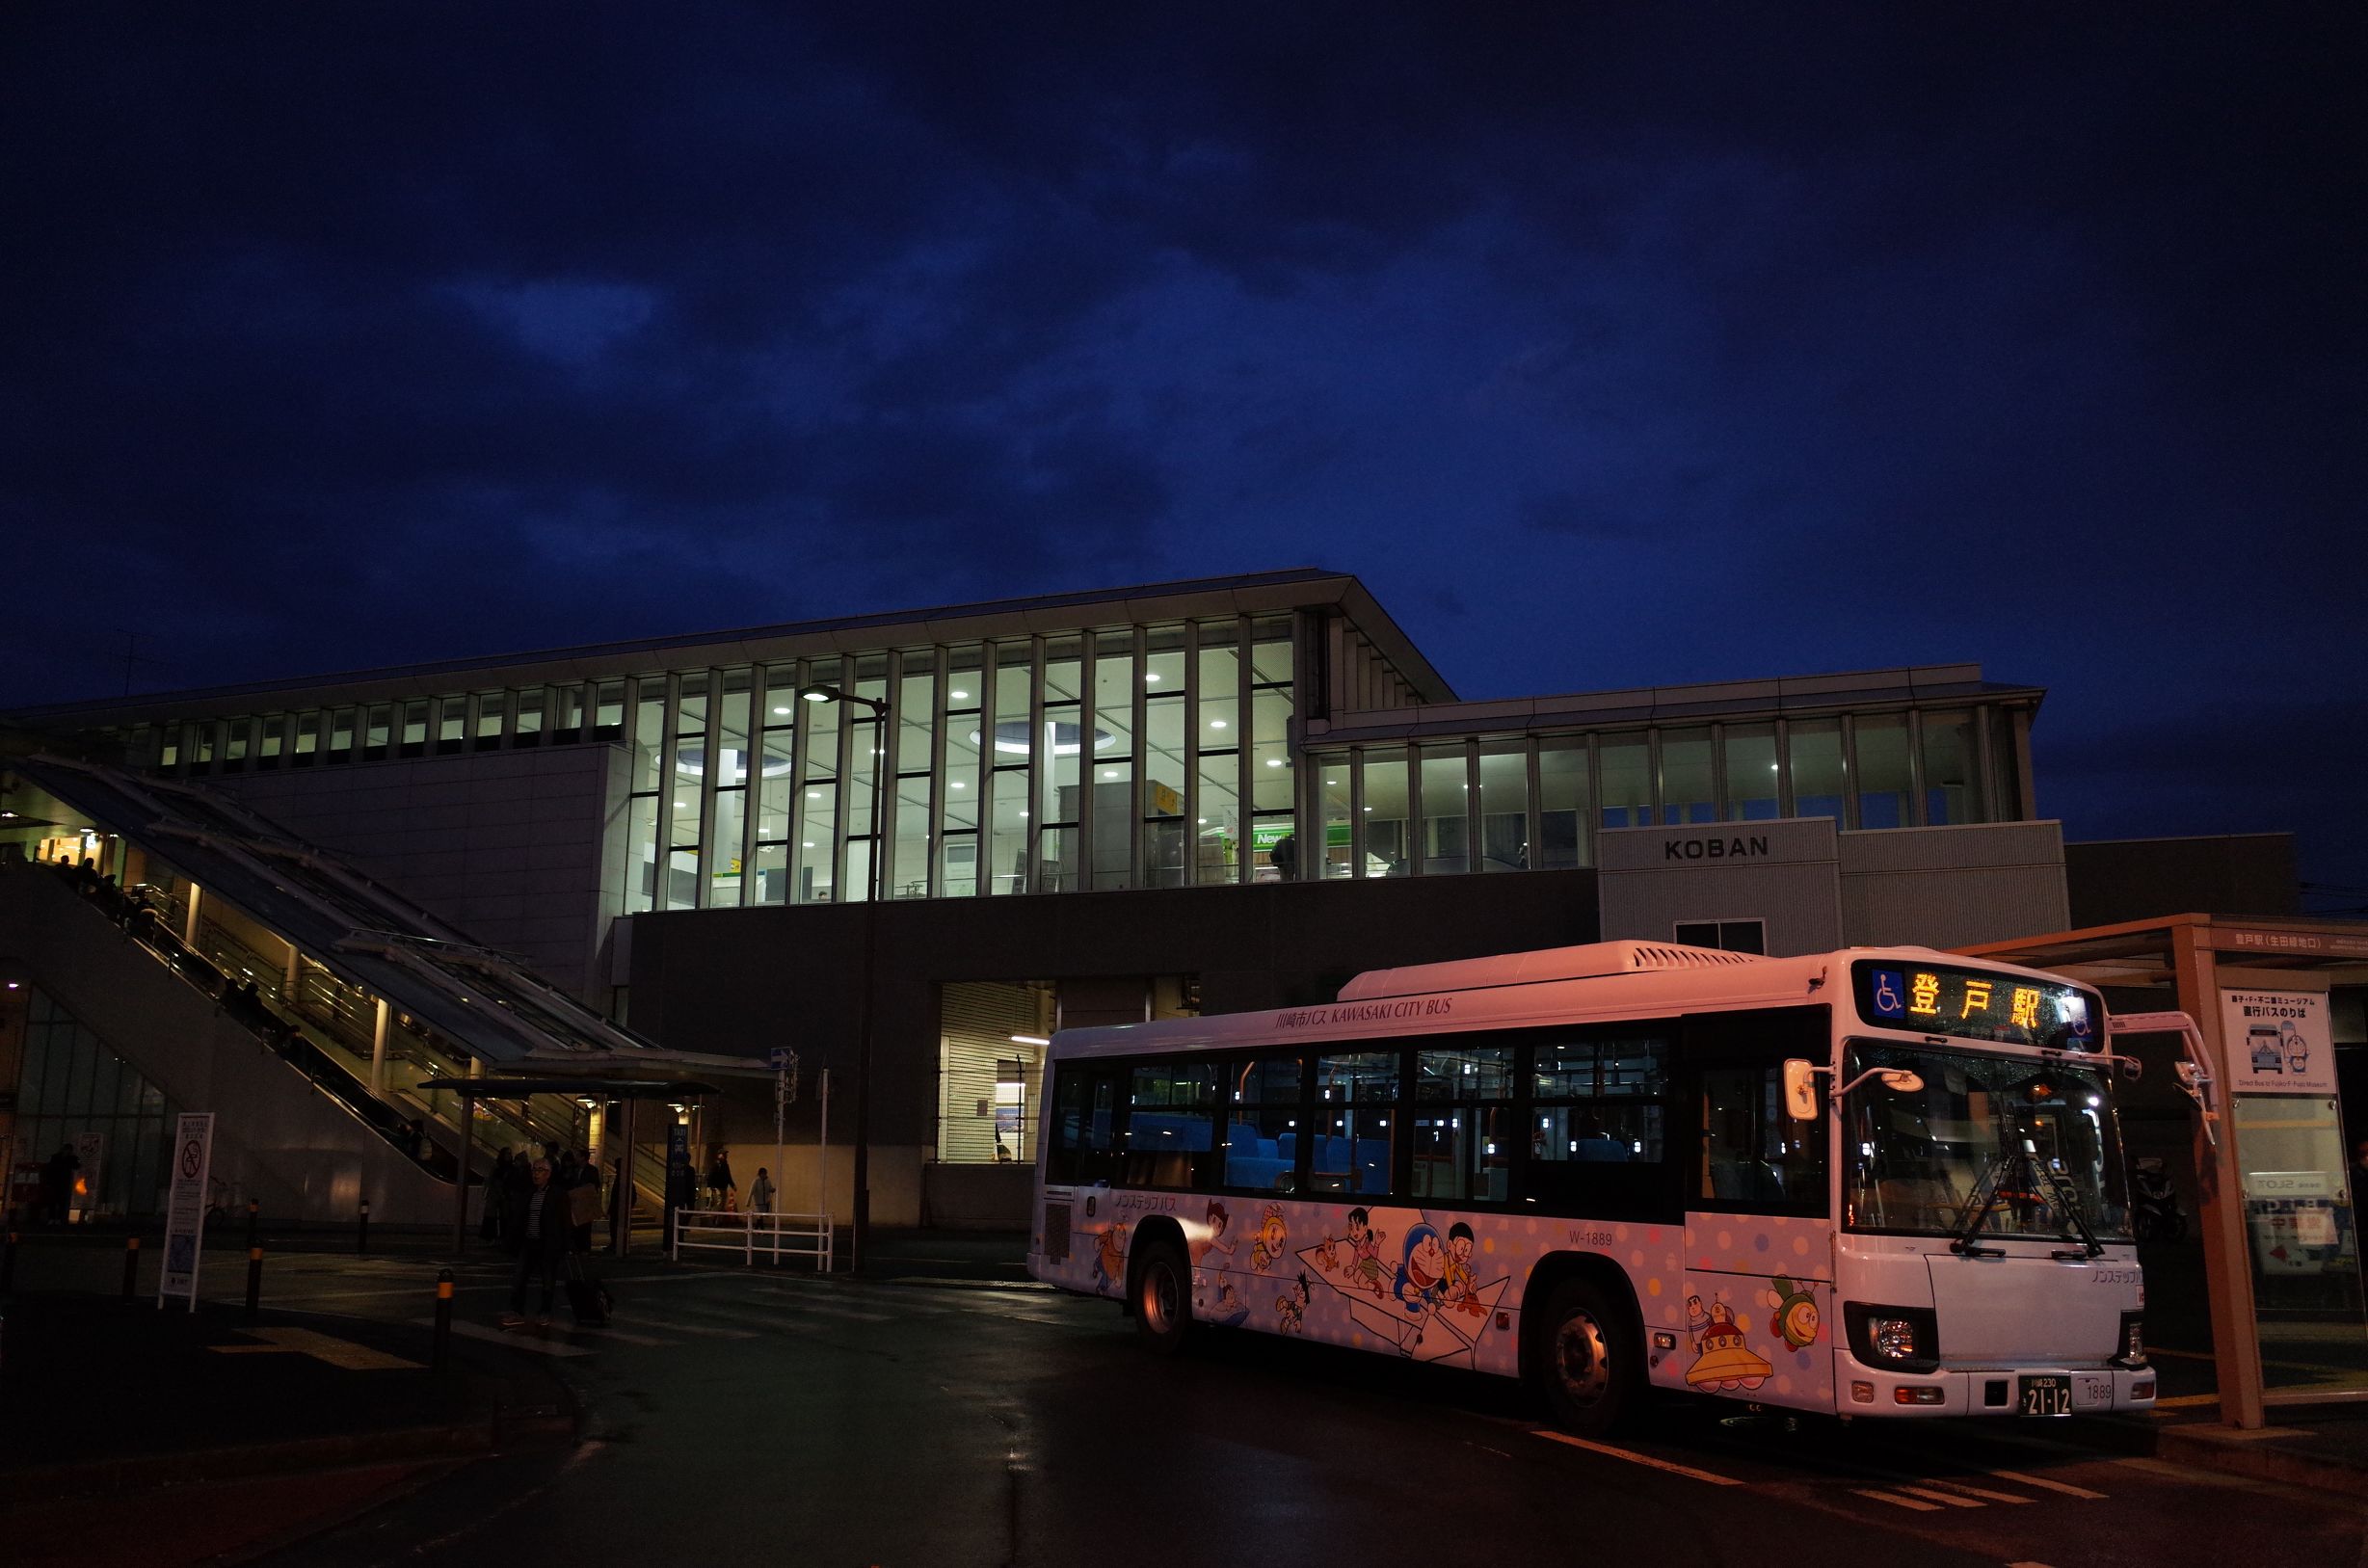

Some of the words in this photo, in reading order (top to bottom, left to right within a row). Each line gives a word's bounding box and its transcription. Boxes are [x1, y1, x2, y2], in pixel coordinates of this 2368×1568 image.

[1664, 836, 1769, 860] KOBAN
[1909, 971, 2041, 1028] 登戸駅
[1275, 1009, 1326, 1029] 川崎市バス
[1331, 1003, 1393, 1023] KAWASAKI
[1394, 1000, 1423, 1018] CITY
[1425, 997, 1452, 1015] BUS
[2243, 1005, 2306, 1018] 直行バスのりば
[1115, 1194, 1177, 1211] ノンステップバス
[1569, 1230, 1612, 1246] W-1889
[2088, 1385, 2112, 1399] 1889
